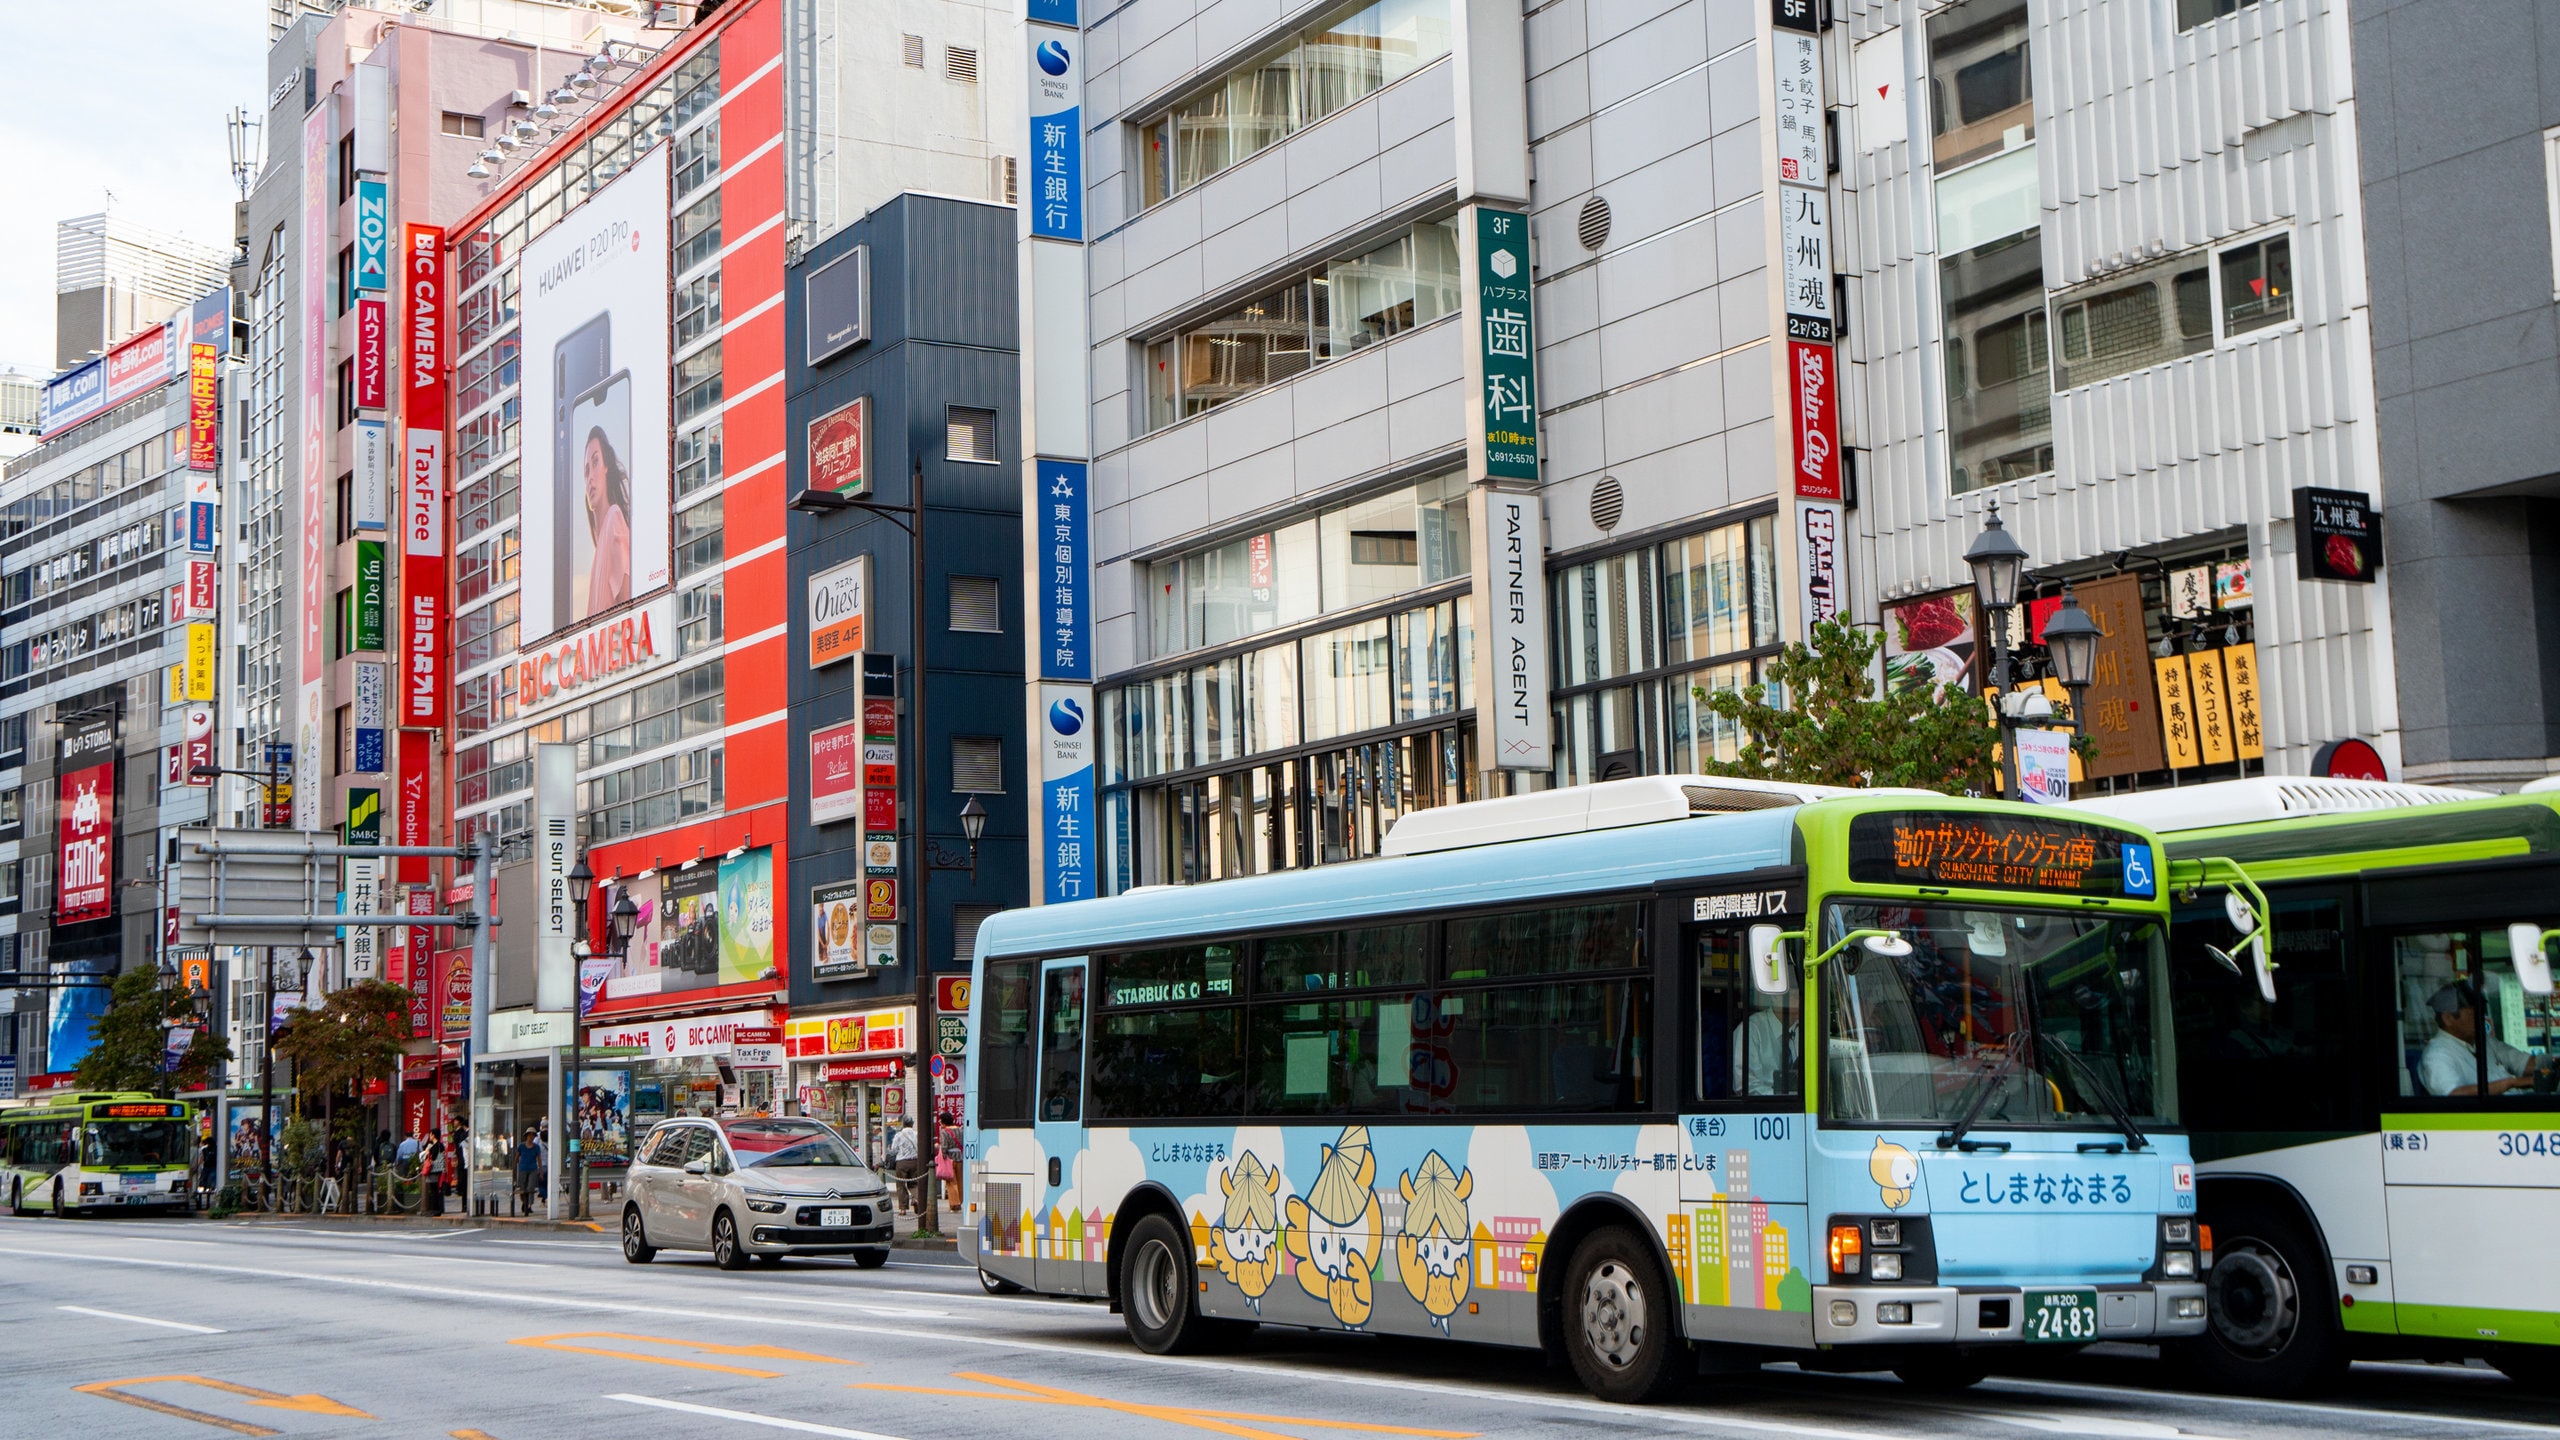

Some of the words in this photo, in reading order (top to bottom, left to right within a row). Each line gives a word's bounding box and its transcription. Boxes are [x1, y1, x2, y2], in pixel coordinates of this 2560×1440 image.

[1784, 0, 1806, 18] 5F
[1041, 79, 1068, 91] SHINSEI
[1044, 89, 1064, 99] BANK
[1781, 78, 1797, 132] もつ鍋
[1801, 126, 1817, 181] 馬刺し
[1043, 122, 1068, 230] 新生銀行
[361, 196, 385, 276] NOVA
[1493, 218, 1510, 235] 3F
[414, 233, 435, 276] BIC
[539, 244, 585, 297] HUAWEI
[590, 228, 608, 261] P20
[611, 221, 628, 247] Pro
[1795, 192, 1825, 310] 九州魂
[1484, 285, 1528, 301] ハプラス
[414, 281, 435, 388] CAMERA
[1789, 319, 1829, 338] 2F/3F
[364, 306, 381, 401] ハウスメイト
[1486, 308, 1531, 424] 歯科
[192, 357, 215, 453] 指圧マッサージ
[1800, 348, 1829, 480] Kirin-City
[1488, 431, 1534, 446] 夜10時まで
[1495, 453, 1535, 464] 6912-5570
[413, 445, 435, 541] TaxFree
[1801, 485, 1832, 494] キリンシティ
[2313, 504, 2361, 528] 九州魂
[1506, 504, 1524, 624] PARTNER
[196, 564, 208, 606] アイフル
[365, 584, 380, 605] De
[1054, 504, 1075, 667] 東京個別指導学院
[842, 626, 860, 642] 4F
[520, 652, 552, 705] BIC
[558, 611, 653, 689] CAMERA
[1512, 637, 1529, 727] AGENT
[1054, 739, 1082, 750] SHINSEI
[1057, 751, 1078, 759] BANK
[351, 830, 378, 839] SMBC
[1056, 786, 1082, 897] 新生銀行
[64, 836, 106, 889] GAME
[552, 841, 563, 874] SUIT
[1939, 862, 1999, 883] SUNSHINE
[2004, 865, 2034, 884] CITY
[2039, 868, 2082, 888] MINAMI
[552, 879, 563, 934] SELECT
[1694, 890, 1787, 921] 国際興業バス
[1116, 983, 1186, 1005] STARBUCKS
[519, 1024, 531, 1036] SUIT
[531, 1022, 549, 1035] SELECT
[689, 1026, 704, 1046] BIC
[706, 1022, 746, 1044] CAME
[829, 1020, 862, 1052] Daily
[940, 1019, 959, 1027] Good
[941, 1027, 967, 1037] BEER
[946, 1069, 954, 1080] R
[1754, 1117, 1790, 1140] 1001
[1152, 1142, 1225, 1163] としまななまる
[1537, 1152, 1677, 1173] 国際アート・カルチャー都市
[1683, 1154, 1717, 1171] としま
[1960, 1171, 2131, 1205] としまななまる
[2176, 1195, 2192, 1208] 1001
[2038, 1307, 2095, 1338] 24-83
